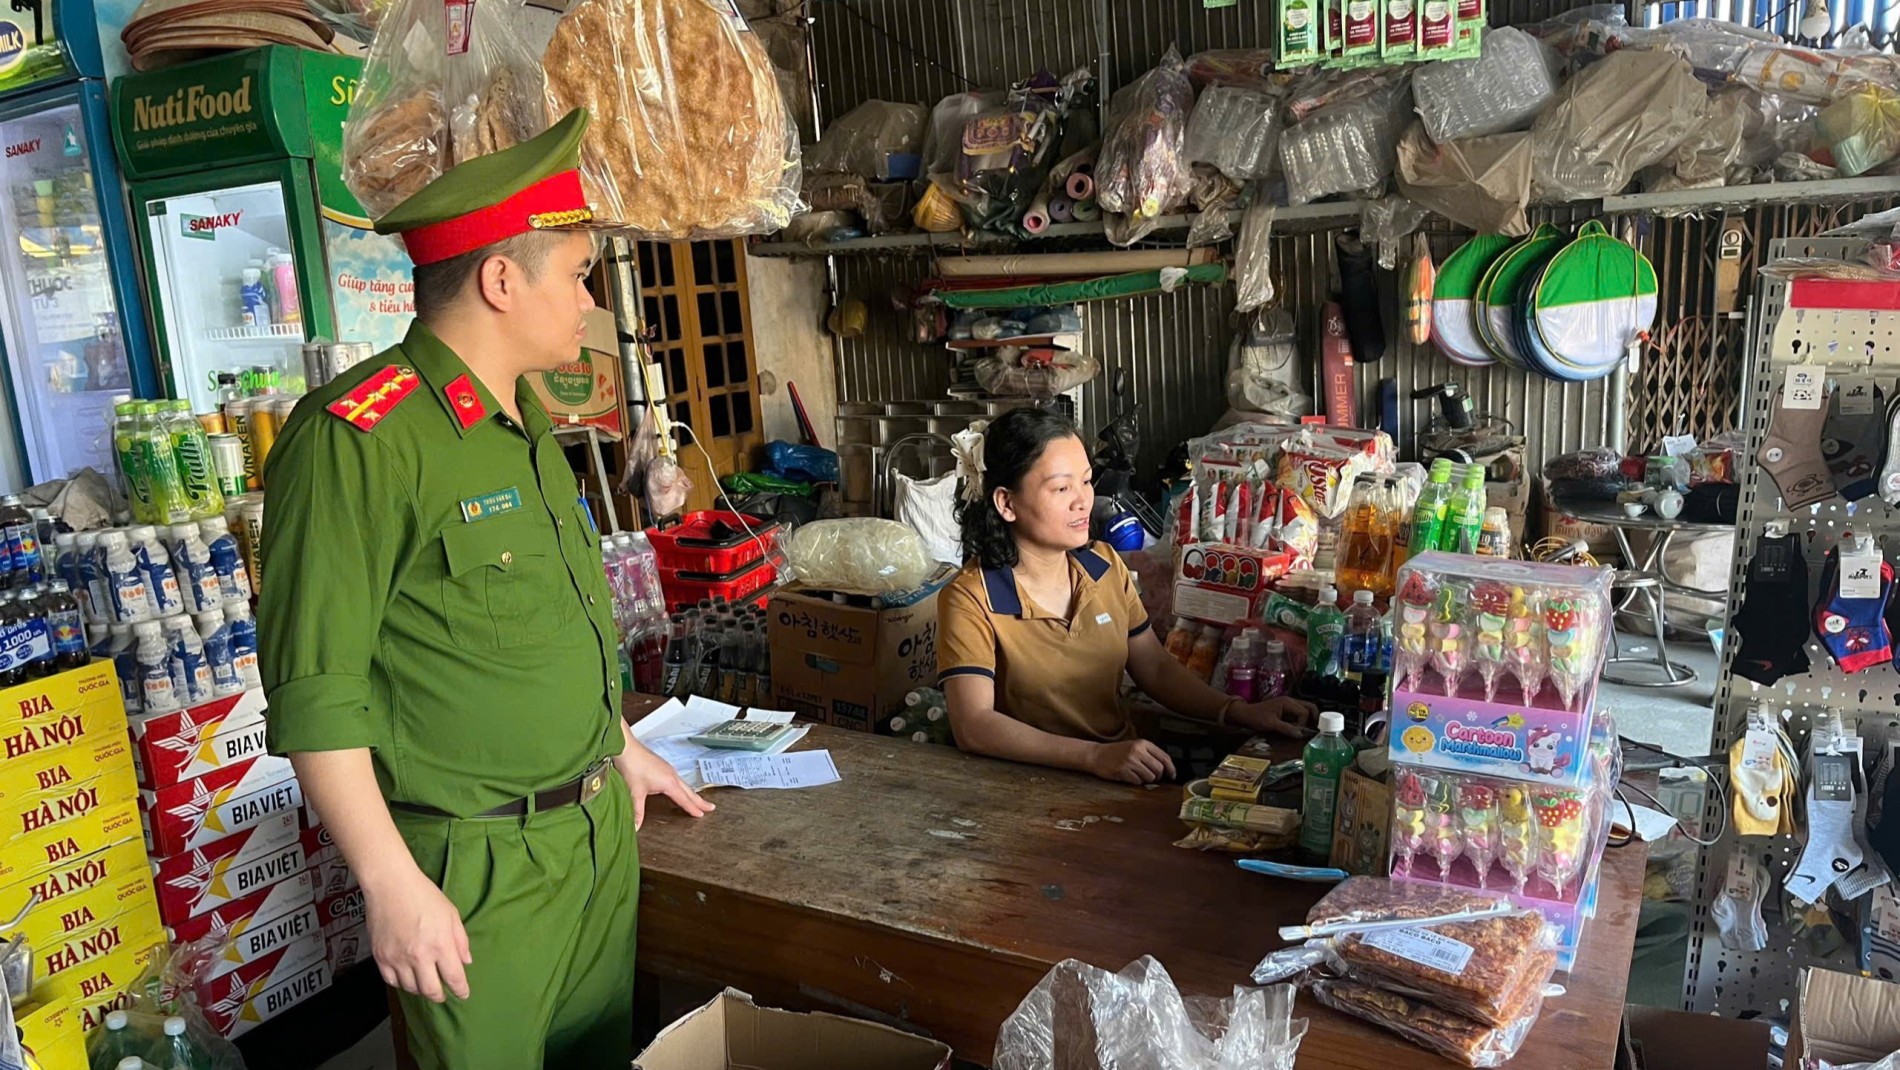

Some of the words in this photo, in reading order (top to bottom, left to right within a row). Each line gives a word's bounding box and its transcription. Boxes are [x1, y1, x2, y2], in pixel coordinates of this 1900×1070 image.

[133, 76, 252, 132] NutiFood
[5, 138, 41, 158] SANAKY
[190, 212, 240, 231] SANAKY
[338, 273, 366, 293] Giúp
[370, 280, 395, 296] tăng
[379, 300, 400, 313] tiêu
[236, 415, 257, 480] VINAKEN
[4, 629, 33, 650] 1000
[18, 694, 54, 719] BIA
[3, 726, 40, 759] HÀ
[40, 714, 85, 745] NỘI
[226, 734, 253, 758] BIA
[1445, 720, 1514, 747] Cartoon
[1440, 739, 1523, 761] Marshmallow
[36, 765, 72, 791] BIA
[21, 801, 56, 834] HÀ
[57, 787, 99, 817] NỘI
[232, 803, 260, 825] BIA
[260, 786, 293, 815] VIỆT
[45, 837, 81, 864] BIA
[29, 874, 65, 904] HÀ
[65, 859, 108, 888] NỘI
[237, 864, 267, 891] BIA
[267, 849, 299, 880] VIỆT
[60, 905, 95, 933] BIA
[249, 926, 278, 955] BIA
[278, 911, 312, 940] VIỆT
[46, 942, 81, 976] HÀ
[81, 926, 122, 955] NỘI
[79, 971, 113, 999] BIA
[267, 985, 292, 1014] BIA
[292, 967, 324, 995] VIỆT
